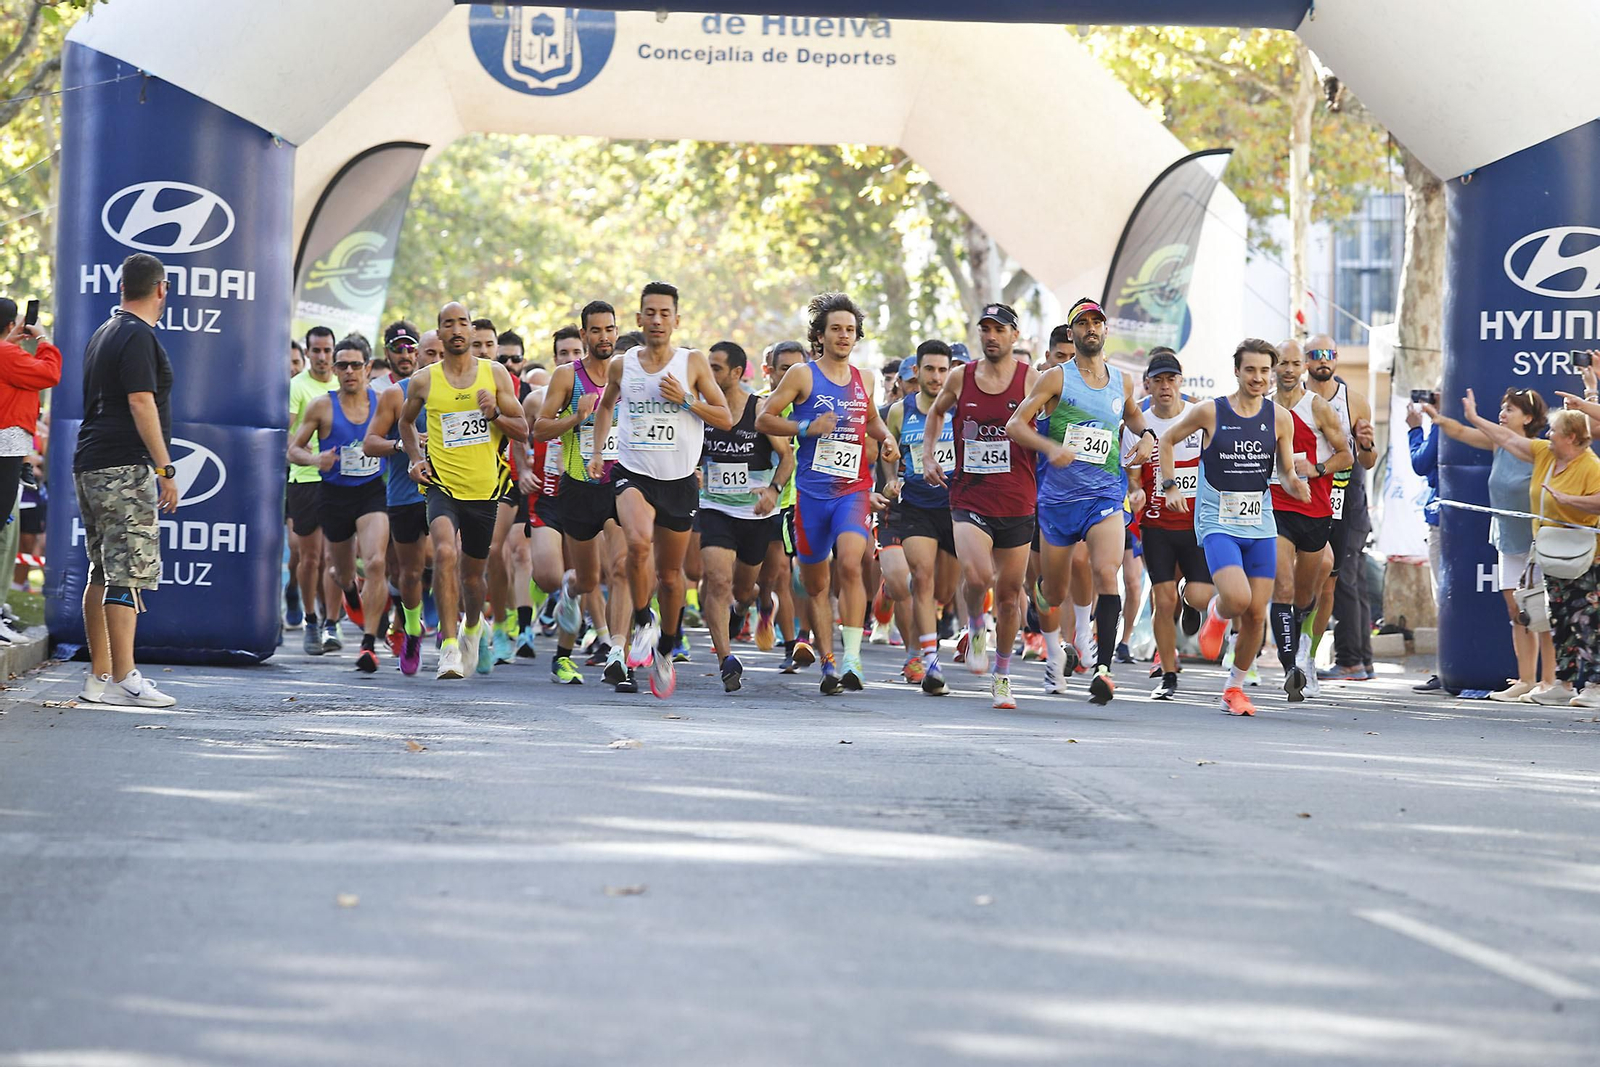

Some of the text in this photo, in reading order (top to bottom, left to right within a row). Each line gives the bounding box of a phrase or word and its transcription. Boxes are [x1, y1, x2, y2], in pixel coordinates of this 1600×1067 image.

[701, 14, 891, 38] de Huelva
[762, 48, 788, 63] de
[796, 48, 896, 67] Deportes
[80, 264, 256, 301] HYNDAI
[1480, 310, 1600, 340] HYUN
[626, 397, 680, 414] bathco
[461, 418, 488, 436] 239
[647, 425, 675, 441] 470
[1083, 436, 1109, 455] 340
[1234, 440, 1262, 453] HGC
[833, 451, 858, 469] 321
[981, 449, 1009, 465] 454
[722, 471, 747, 486] 613
[1239, 500, 1260, 516] 240
